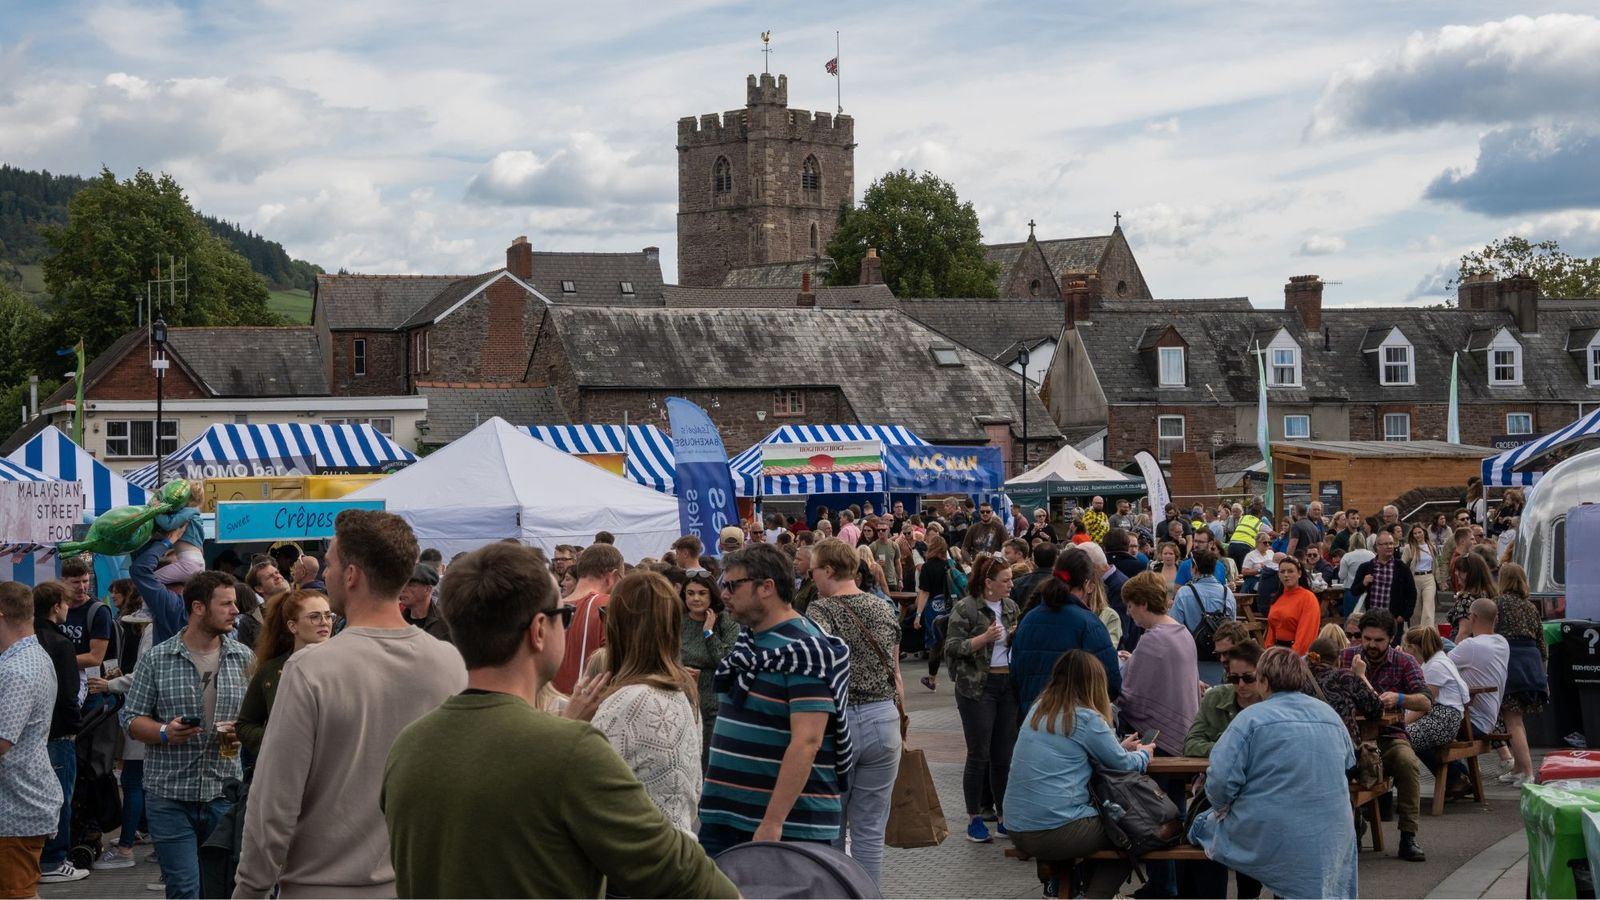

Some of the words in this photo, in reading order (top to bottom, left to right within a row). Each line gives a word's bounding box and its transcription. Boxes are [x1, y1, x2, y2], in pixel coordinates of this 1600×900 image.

[187, 463, 248, 479] MOMO
[252, 462, 283, 477] bar
[17, 482, 80, 498] MALAYSIAN
[37, 504, 80, 519] STREET
[274, 505, 333, 536] Crêpes
[48, 525, 72, 541] FOO
[58, 624, 83, 639] OSS
[1572, 664, 1600, 673] non-recyc
